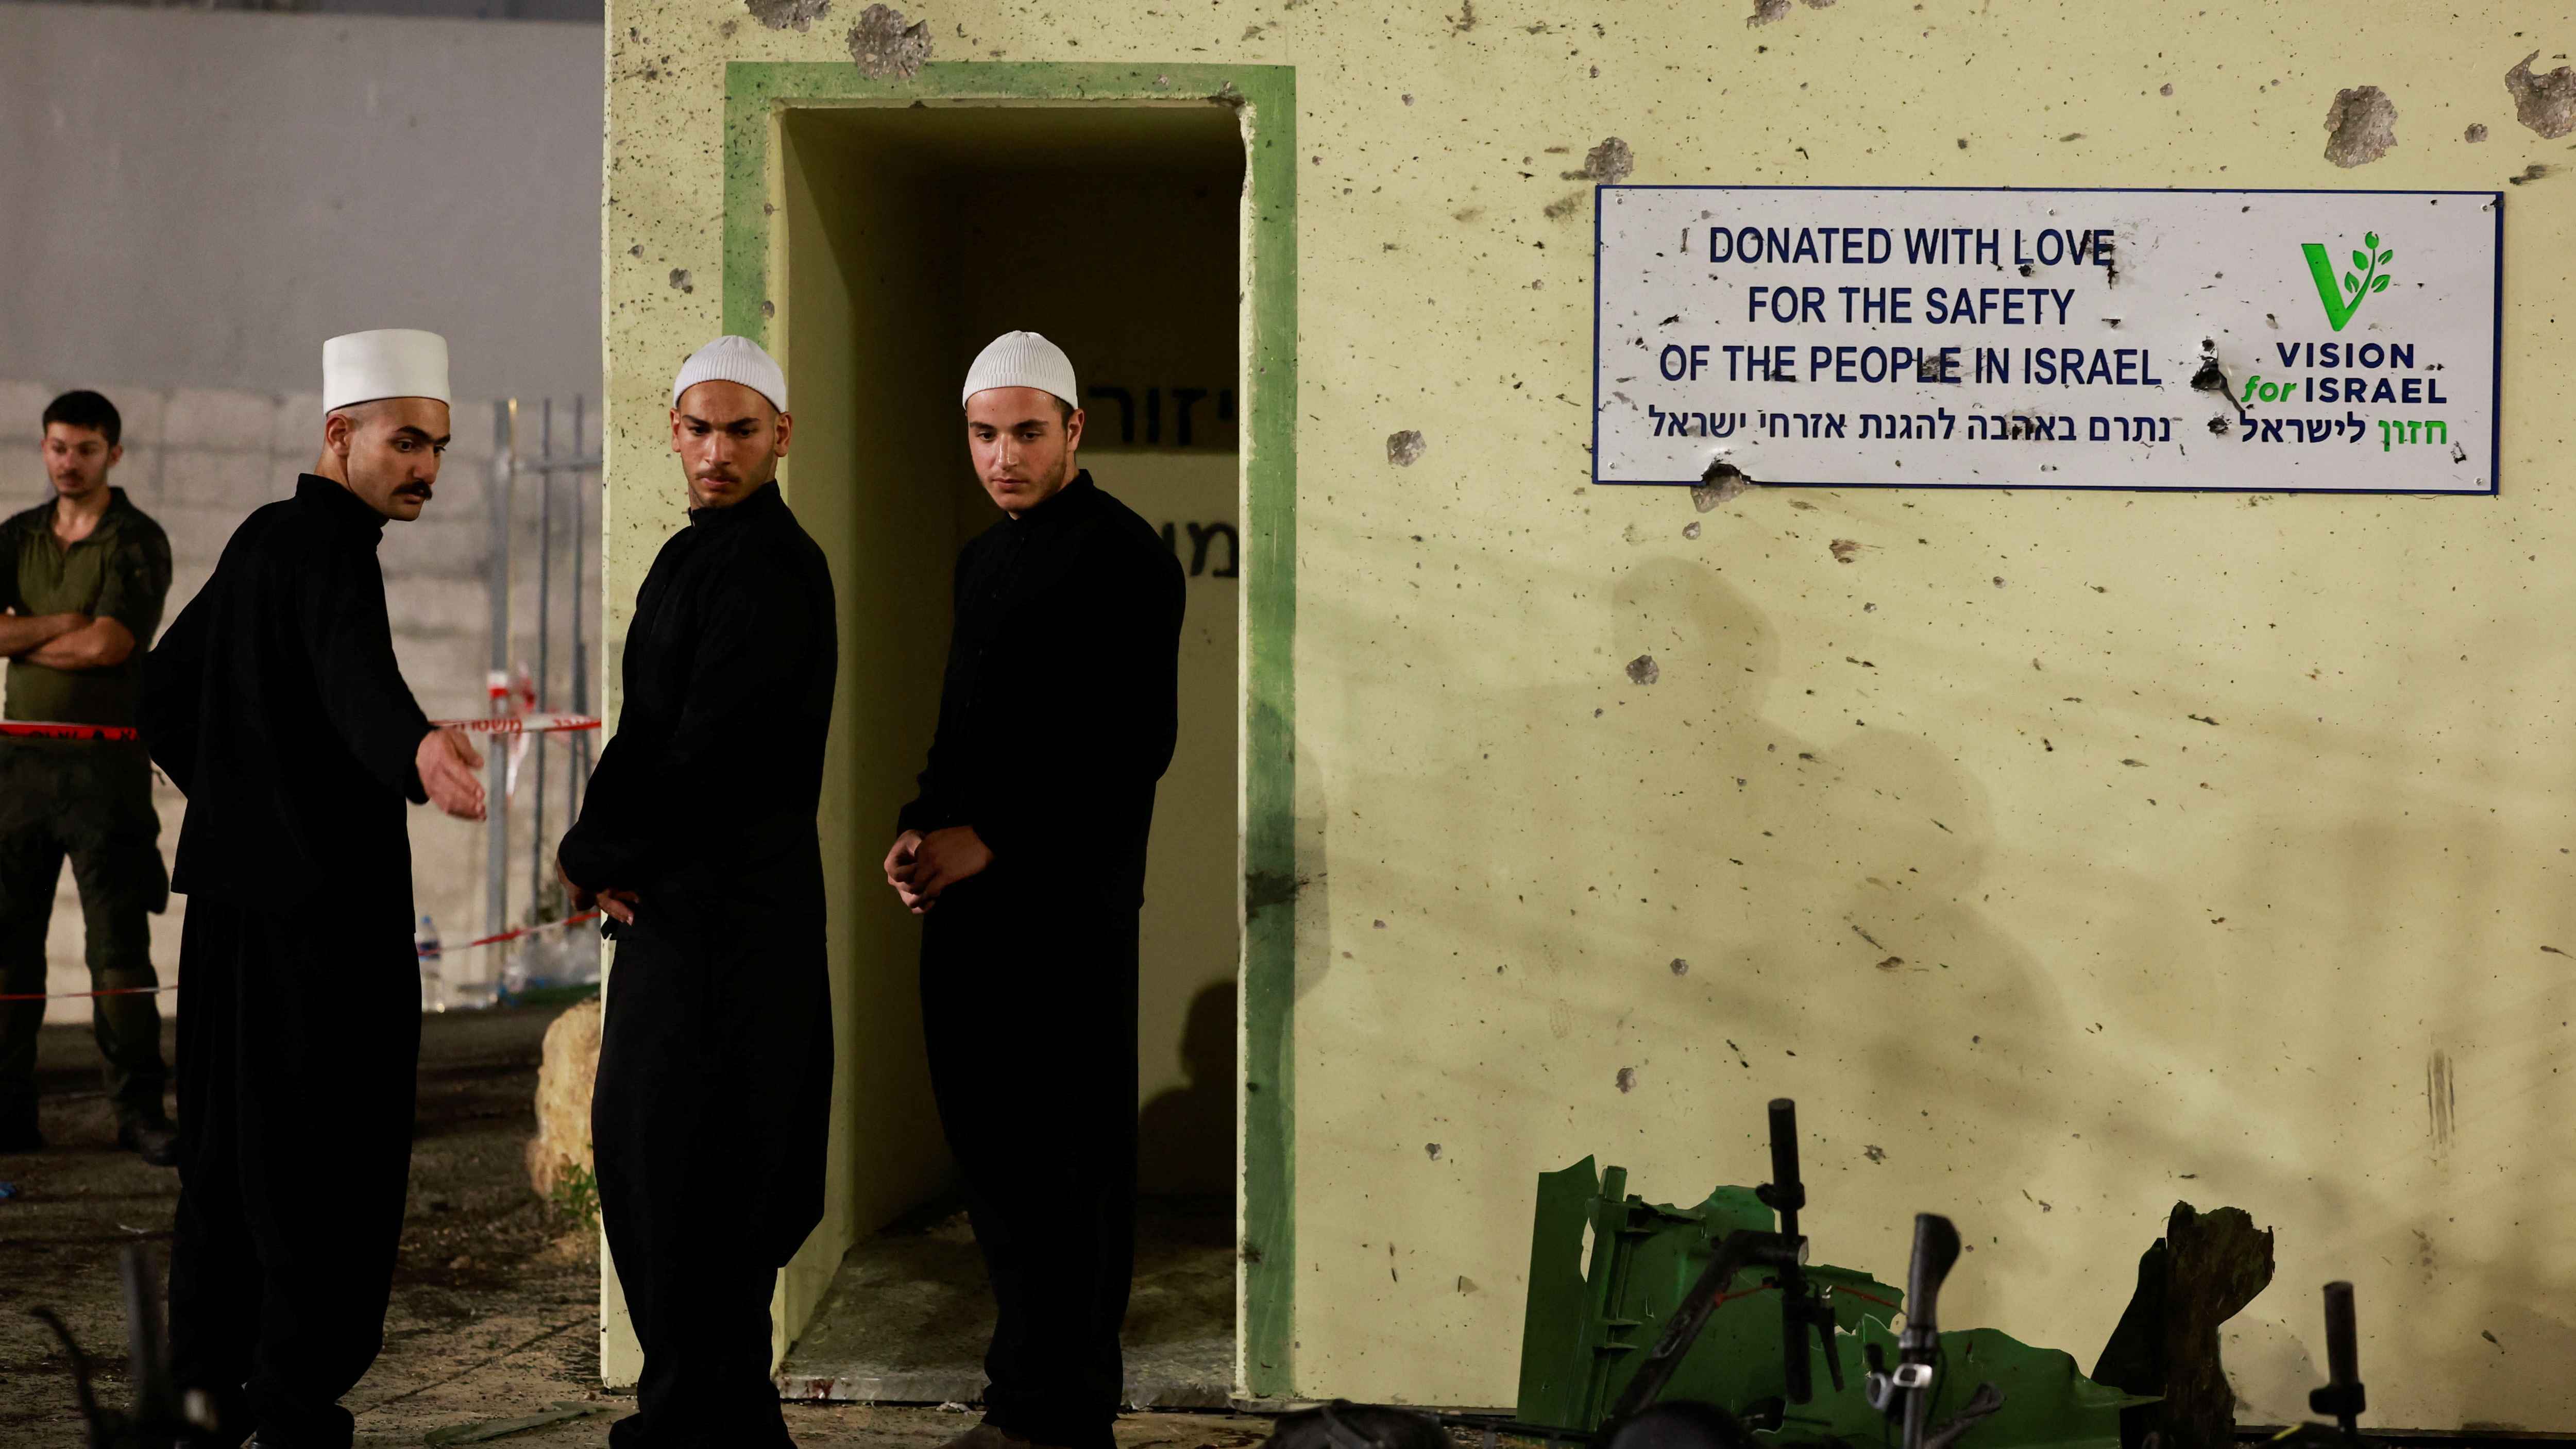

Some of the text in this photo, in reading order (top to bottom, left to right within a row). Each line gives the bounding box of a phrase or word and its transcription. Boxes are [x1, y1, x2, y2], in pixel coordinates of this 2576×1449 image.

[1710, 227, 2115, 267] DONATED WITH LOVE
[1750, 286, 2075, 326] FOR THE SAFETY
[1659, 345, 2162, 386] OF THE PEOPLE IN ISRAEL
[2276, 342, 2414, 369] VISION
[2241, 375, 2448, 404] for ISRAEL
[1649, 404, 2172, 442] נתרם באהבה להגנת אזרחי ישראל
[2240, 411, 2448, 452] חזון לישראל
